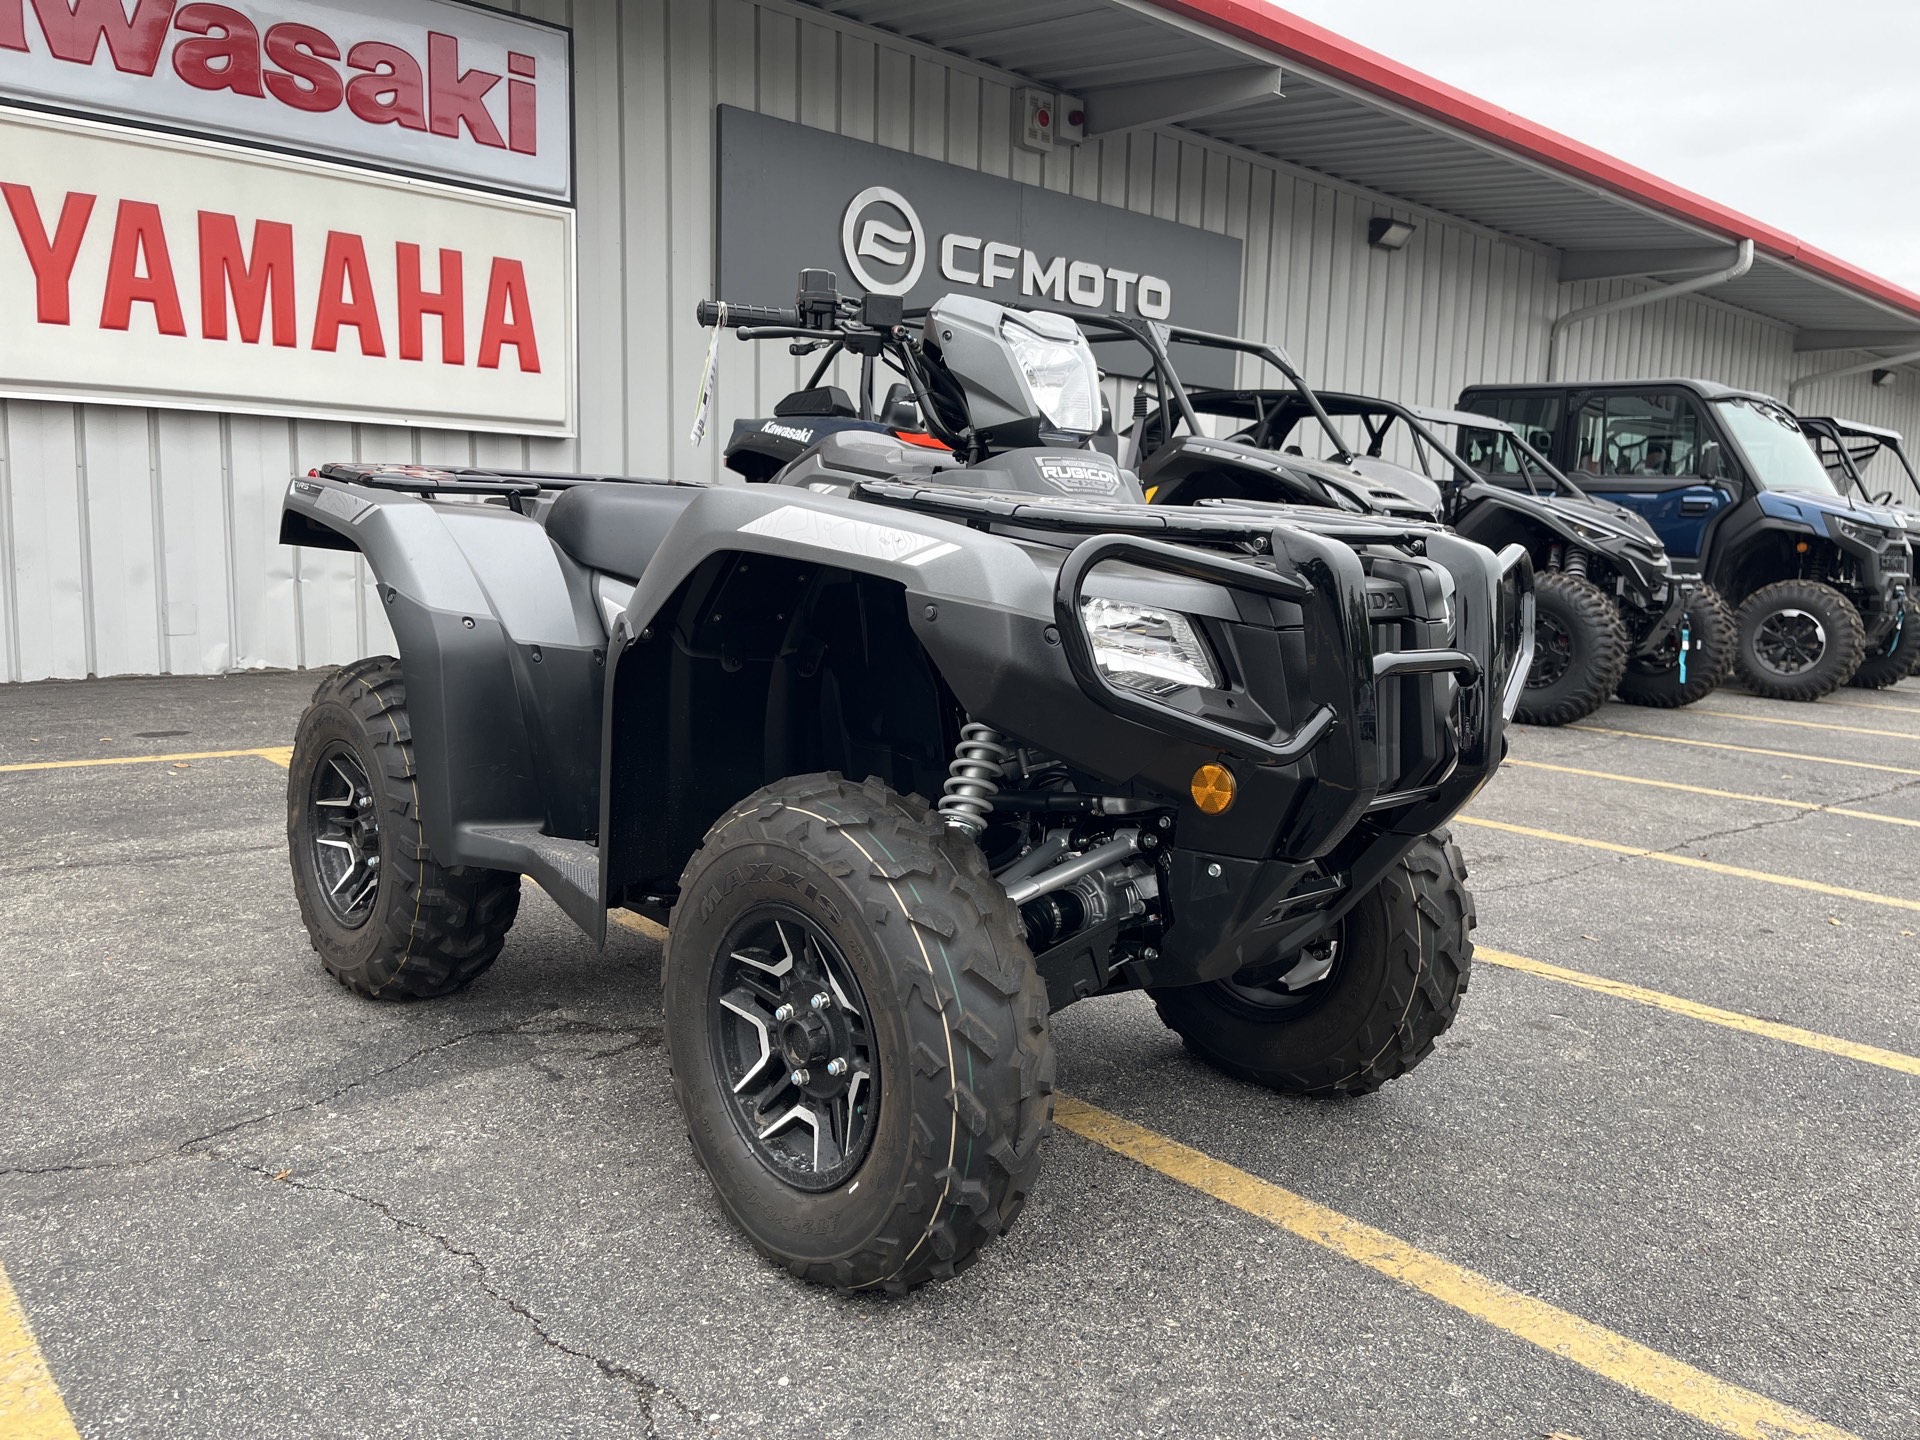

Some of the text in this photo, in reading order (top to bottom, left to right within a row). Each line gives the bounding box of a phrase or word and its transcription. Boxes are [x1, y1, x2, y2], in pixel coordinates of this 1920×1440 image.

[0, 0, 537, 156] wasaki
[0, 181, 541, 374] YAMAHA
[941, 233, 1171, 320] CFMOTO
[760, 420, 814, 443] Kawasaki
[1041, 466, 1120, 485] RUBICON
[700, 863, 842, 927] MAXXIS
